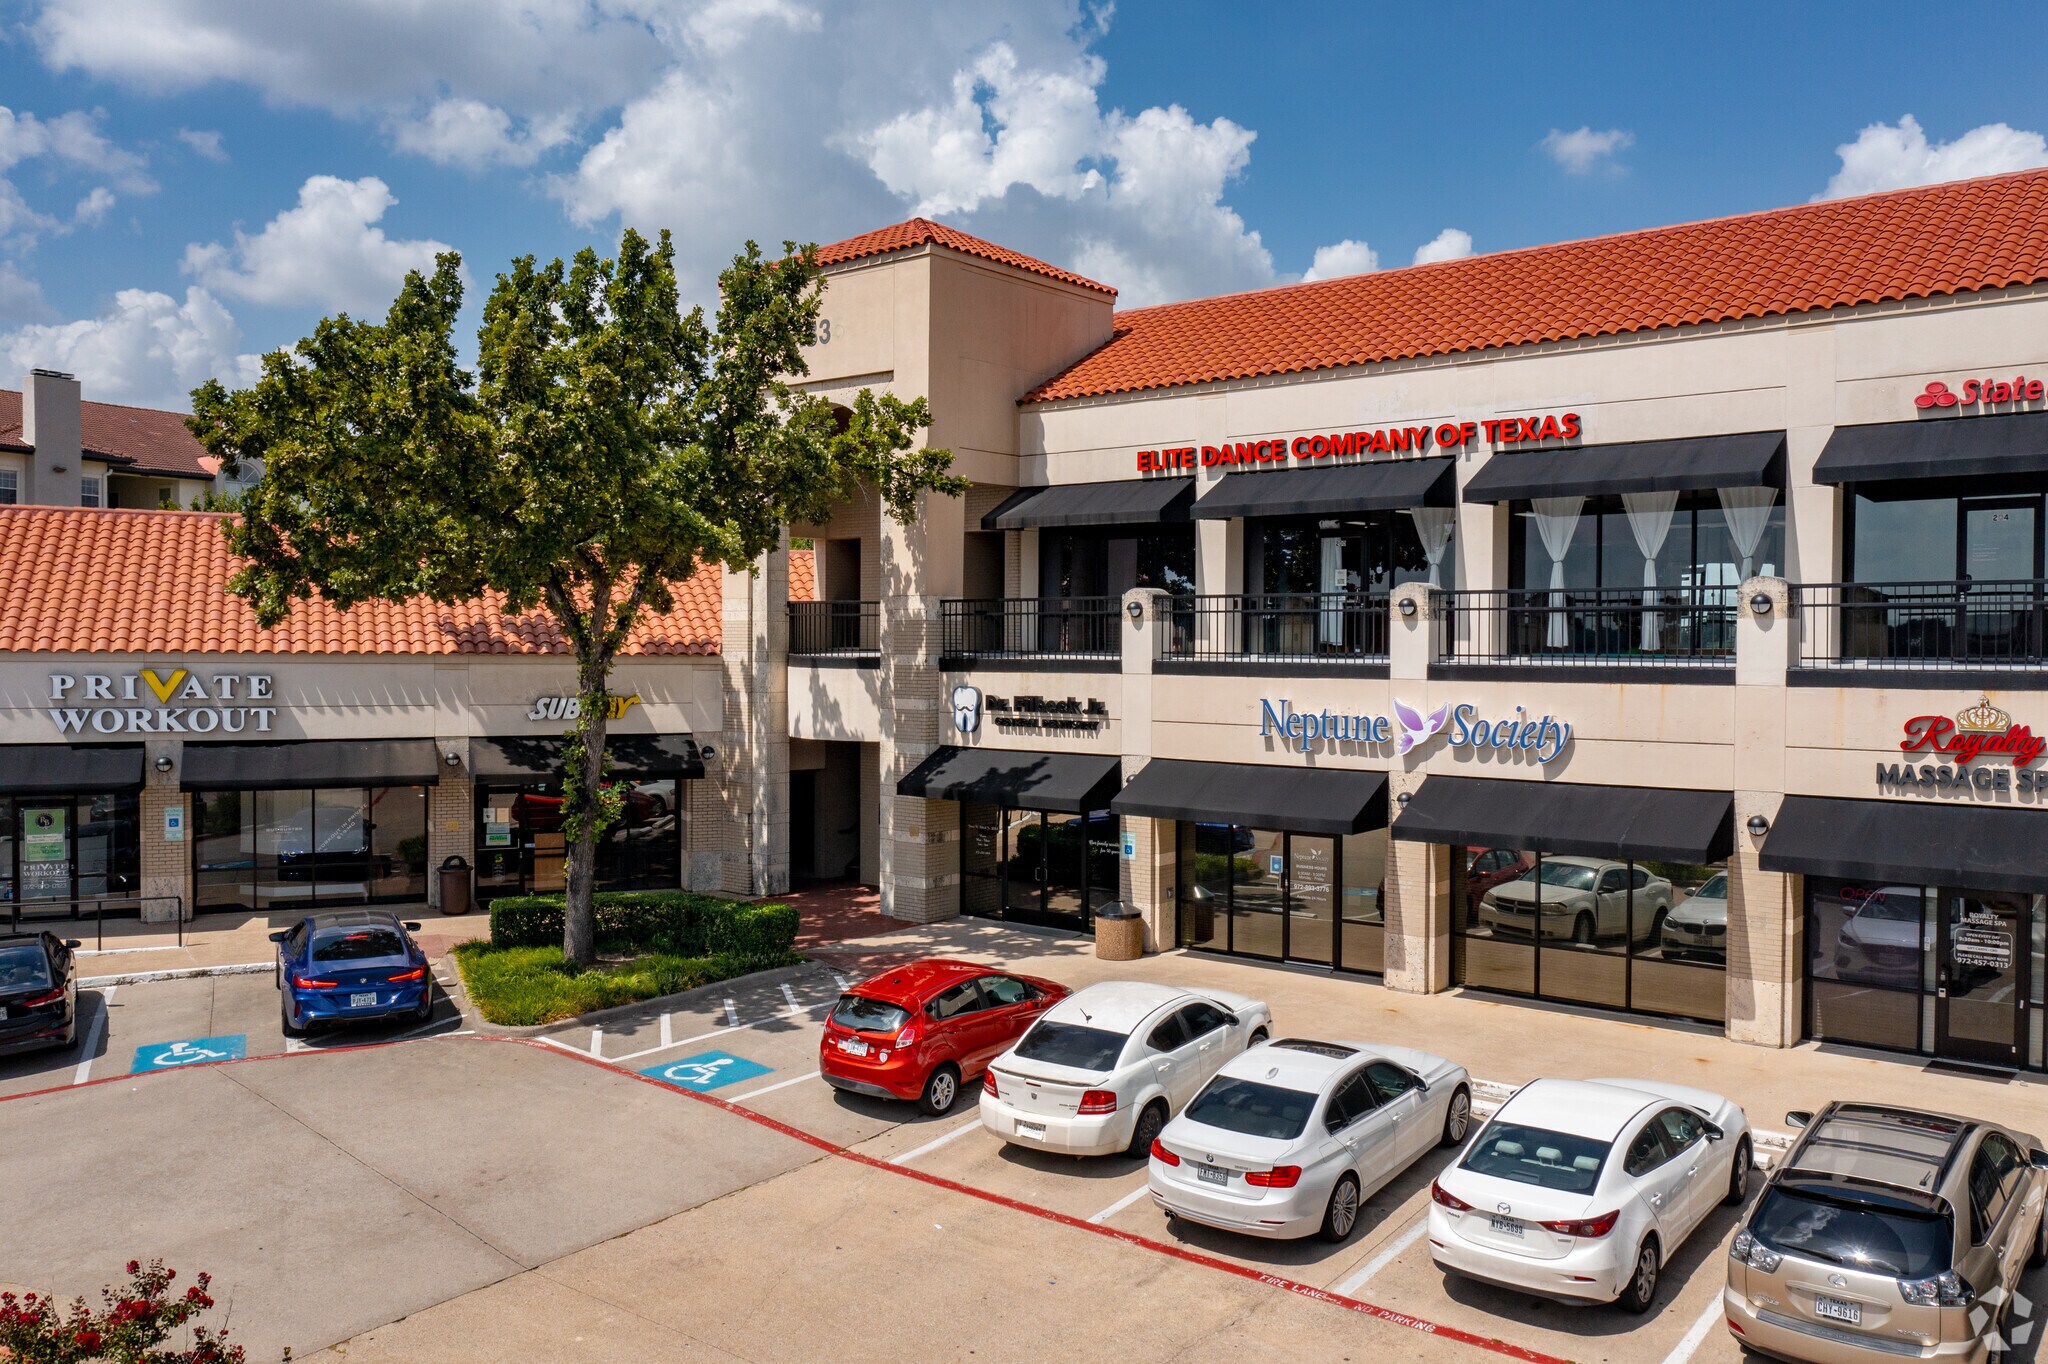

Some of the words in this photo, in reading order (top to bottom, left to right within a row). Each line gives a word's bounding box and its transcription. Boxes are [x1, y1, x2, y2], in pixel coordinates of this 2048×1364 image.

[1958, 375, 2044, 406] State
[1137, 446, 1196, 472] ELITE
[1201, 438, 1287, 467] DANCE
[1291, 425, 1432, 460] COMPANY
[1435, 421, 1478, 448] OF
[1481, 413, 1581, 444] TEXAS
[48, 669, 273, 705] PRIVATE
[527, 695, 641, 721] SUBY
[48, 707, 277, 735] WORKOUT
[994, 716, 1042, 729] GENERAL
[1041, 718, 1100, 731] DENTISTRY
[1259, 698, 1391, 752] Neptune
[1447, 703, 1572, 764] Society
[1899, 715, 2047, 768] Royalty
[1876, 762, 2011, 792] MASSAGE
[23, 863, 66, 871] PRIVATE
[1840, 886, 1888, 902] OPEN
[1960, 917, 1993, 926] MASSAGE
[1969, 912, 1999, 920] ROYALTY
[1984, 939, 2010, 947] 10:00pm
[1957, 957, 2009, 969] 972-457-0313
[1500, 1214, 1515, 1222] TEXAS
[1259, 1274, 1289, 1288] FIRE
[1292, 1284, 1325, 1300] LANE
[1353, 1302, 1374, 1314] NO
[1377, 1310, 1437, 1333] PARKING
[1829, 1298, 1848, 1306] TEXAS
